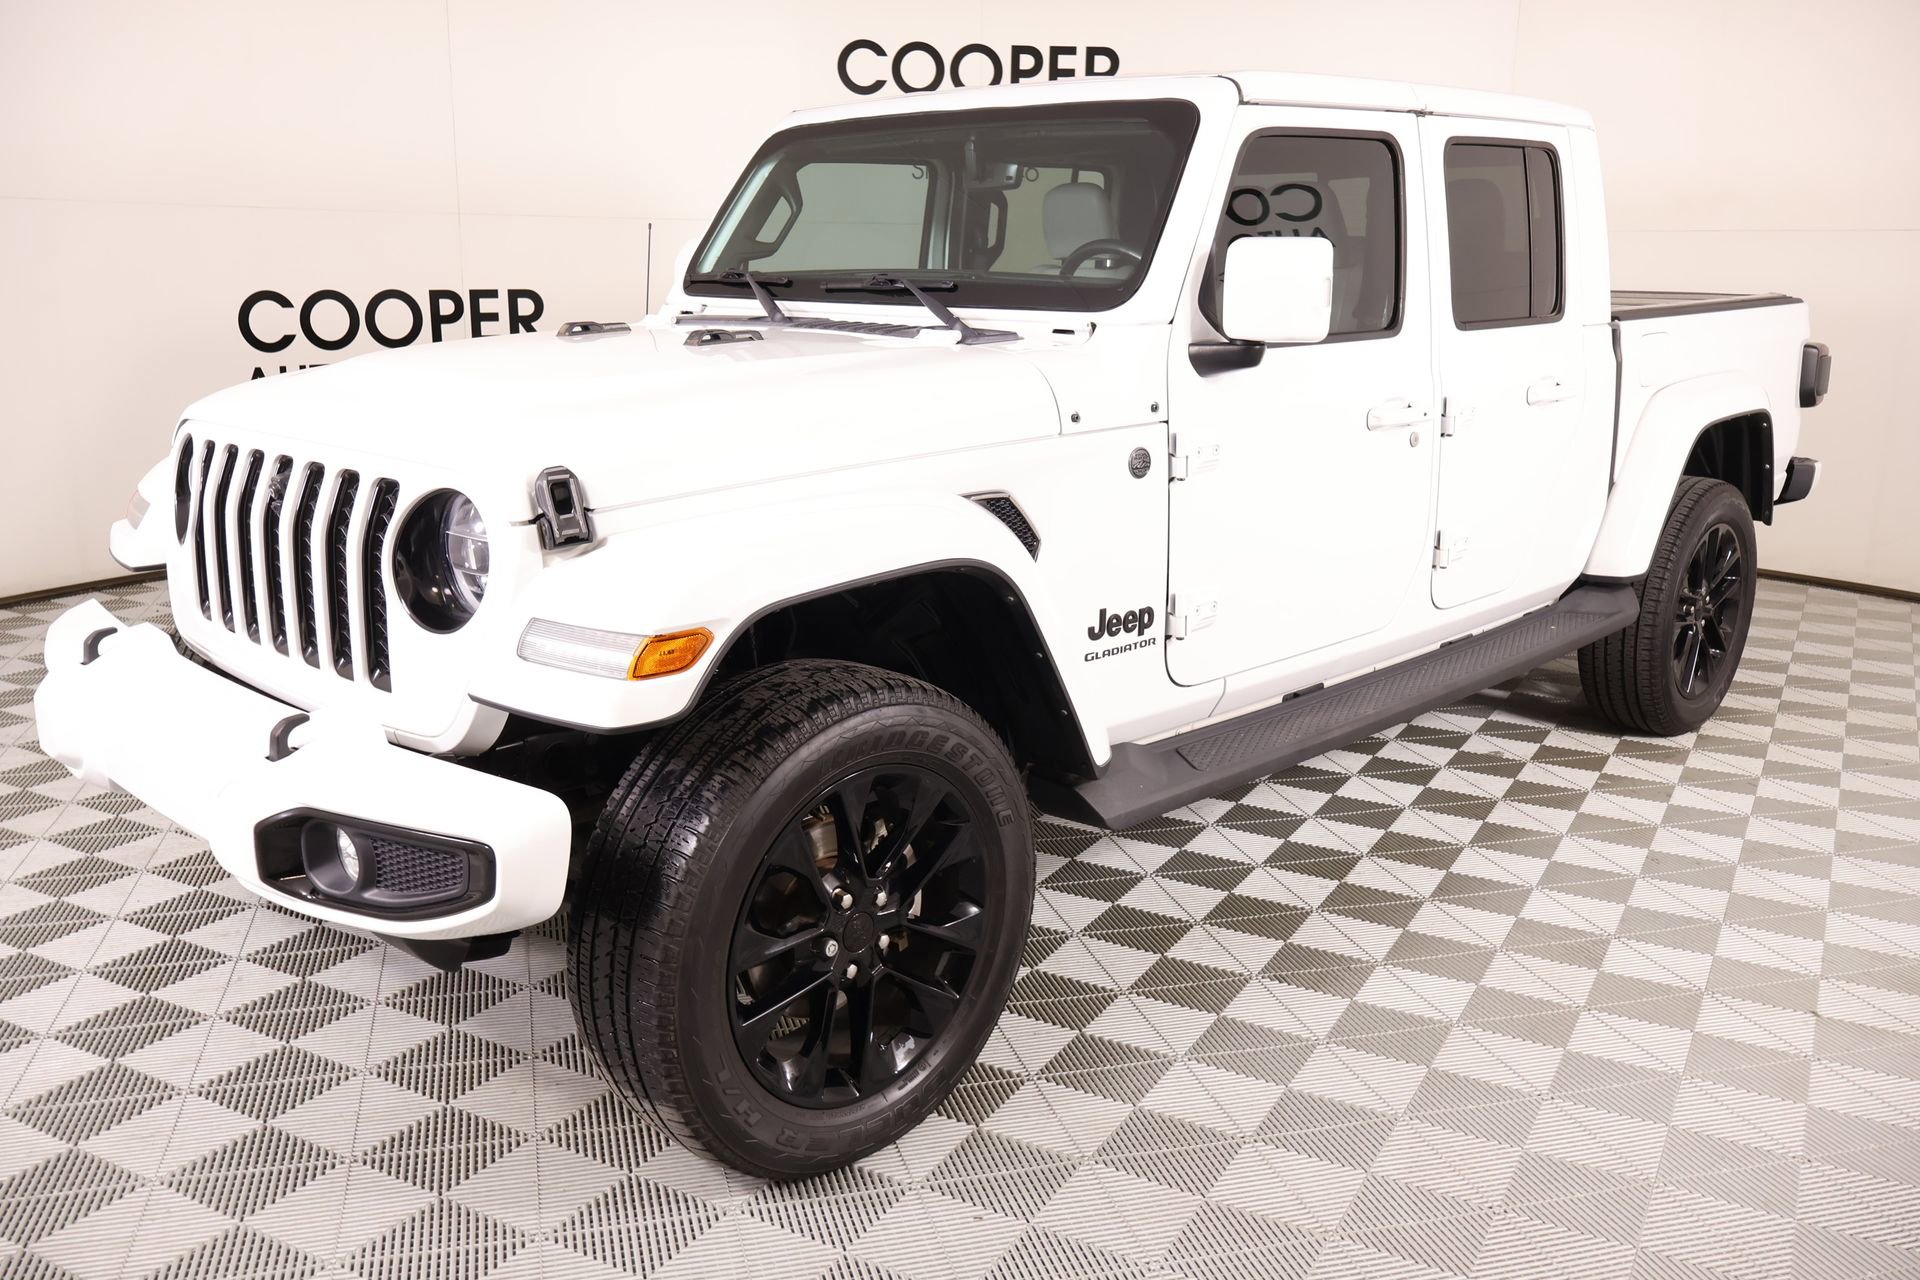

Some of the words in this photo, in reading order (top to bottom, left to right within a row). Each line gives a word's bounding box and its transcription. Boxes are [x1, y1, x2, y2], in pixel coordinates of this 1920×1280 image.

[837, 39, 1120, 95] COOPER
[238, 289, 544, 353] COOPER
[1087, 606, 1155, 641] Jeep
[1084, 637, 1156, 663] GLADIATOR
